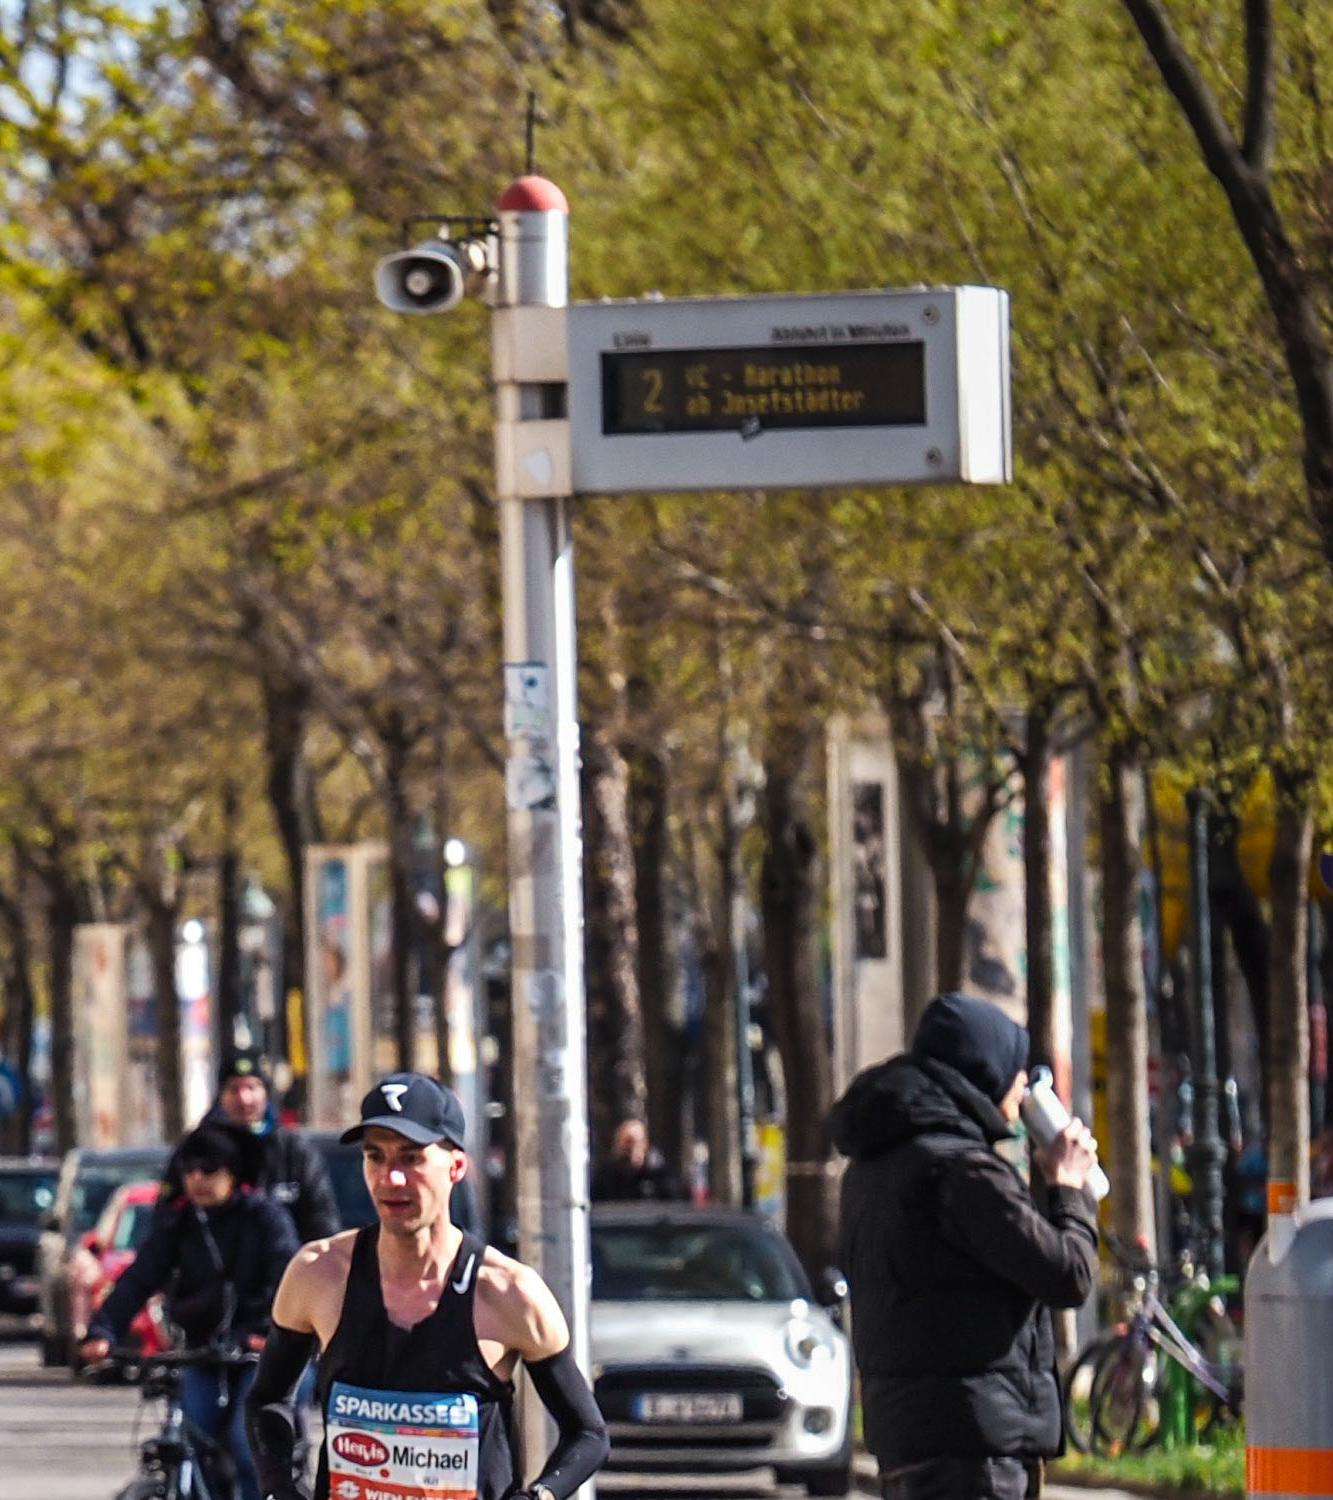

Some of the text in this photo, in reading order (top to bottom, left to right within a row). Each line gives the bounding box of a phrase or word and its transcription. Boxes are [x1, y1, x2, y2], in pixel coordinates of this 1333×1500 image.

[642, 368, 664, 414] 2
[744, 363, 841, 388] Marathon
[686, 392, 712, 416] ab
[335, 1394, 449, 1426] SPARKASSE
[337, 1436, 469, 1471] Hervis Michael
